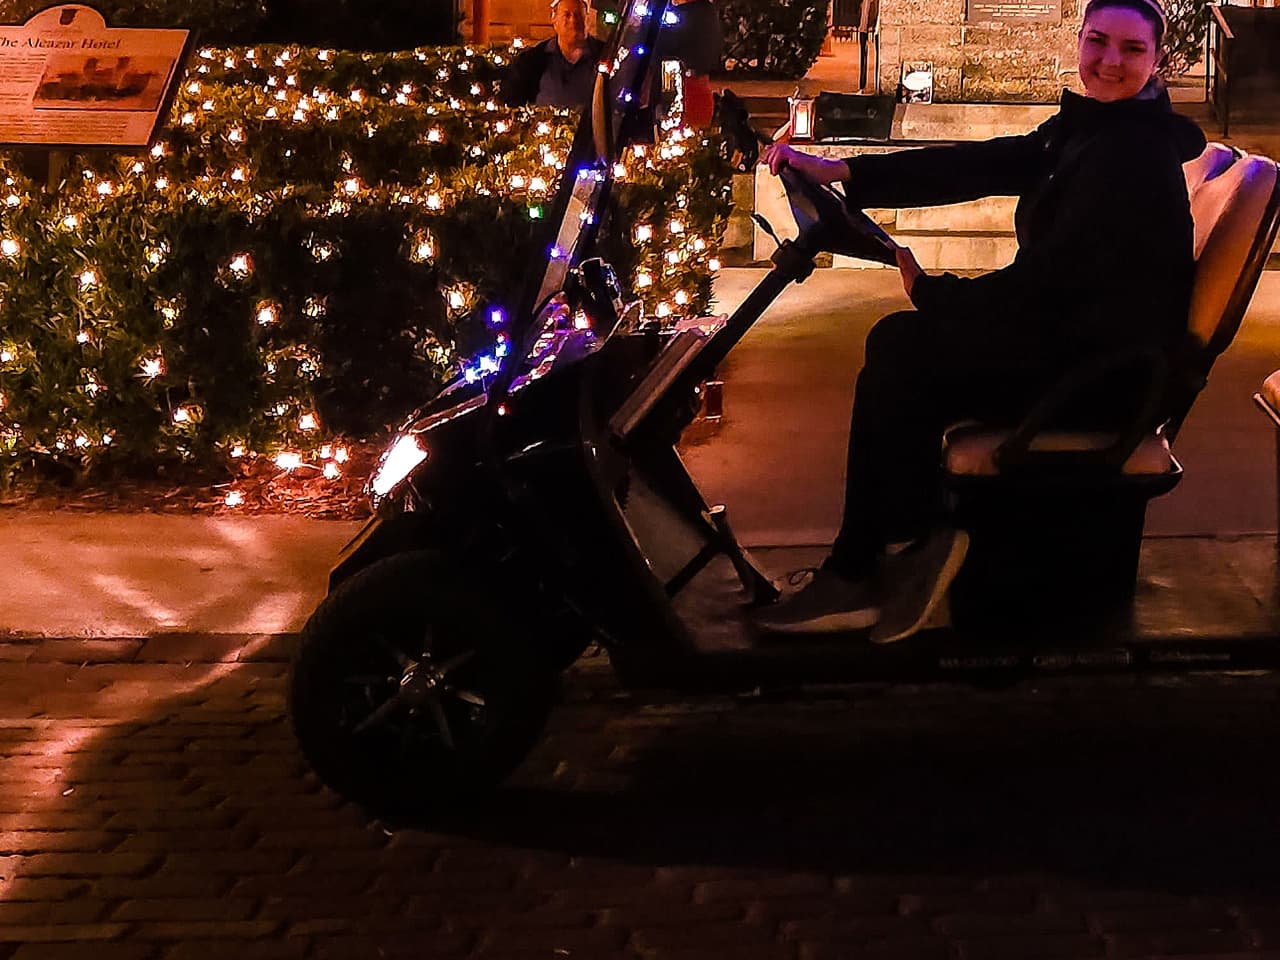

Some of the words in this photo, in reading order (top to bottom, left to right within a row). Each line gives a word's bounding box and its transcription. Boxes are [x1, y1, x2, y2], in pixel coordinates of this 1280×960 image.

[0, 36, 19, 48] he
[22, 36, 77, 50] Alcazar
[81, 38, 122, 50] Hotel
